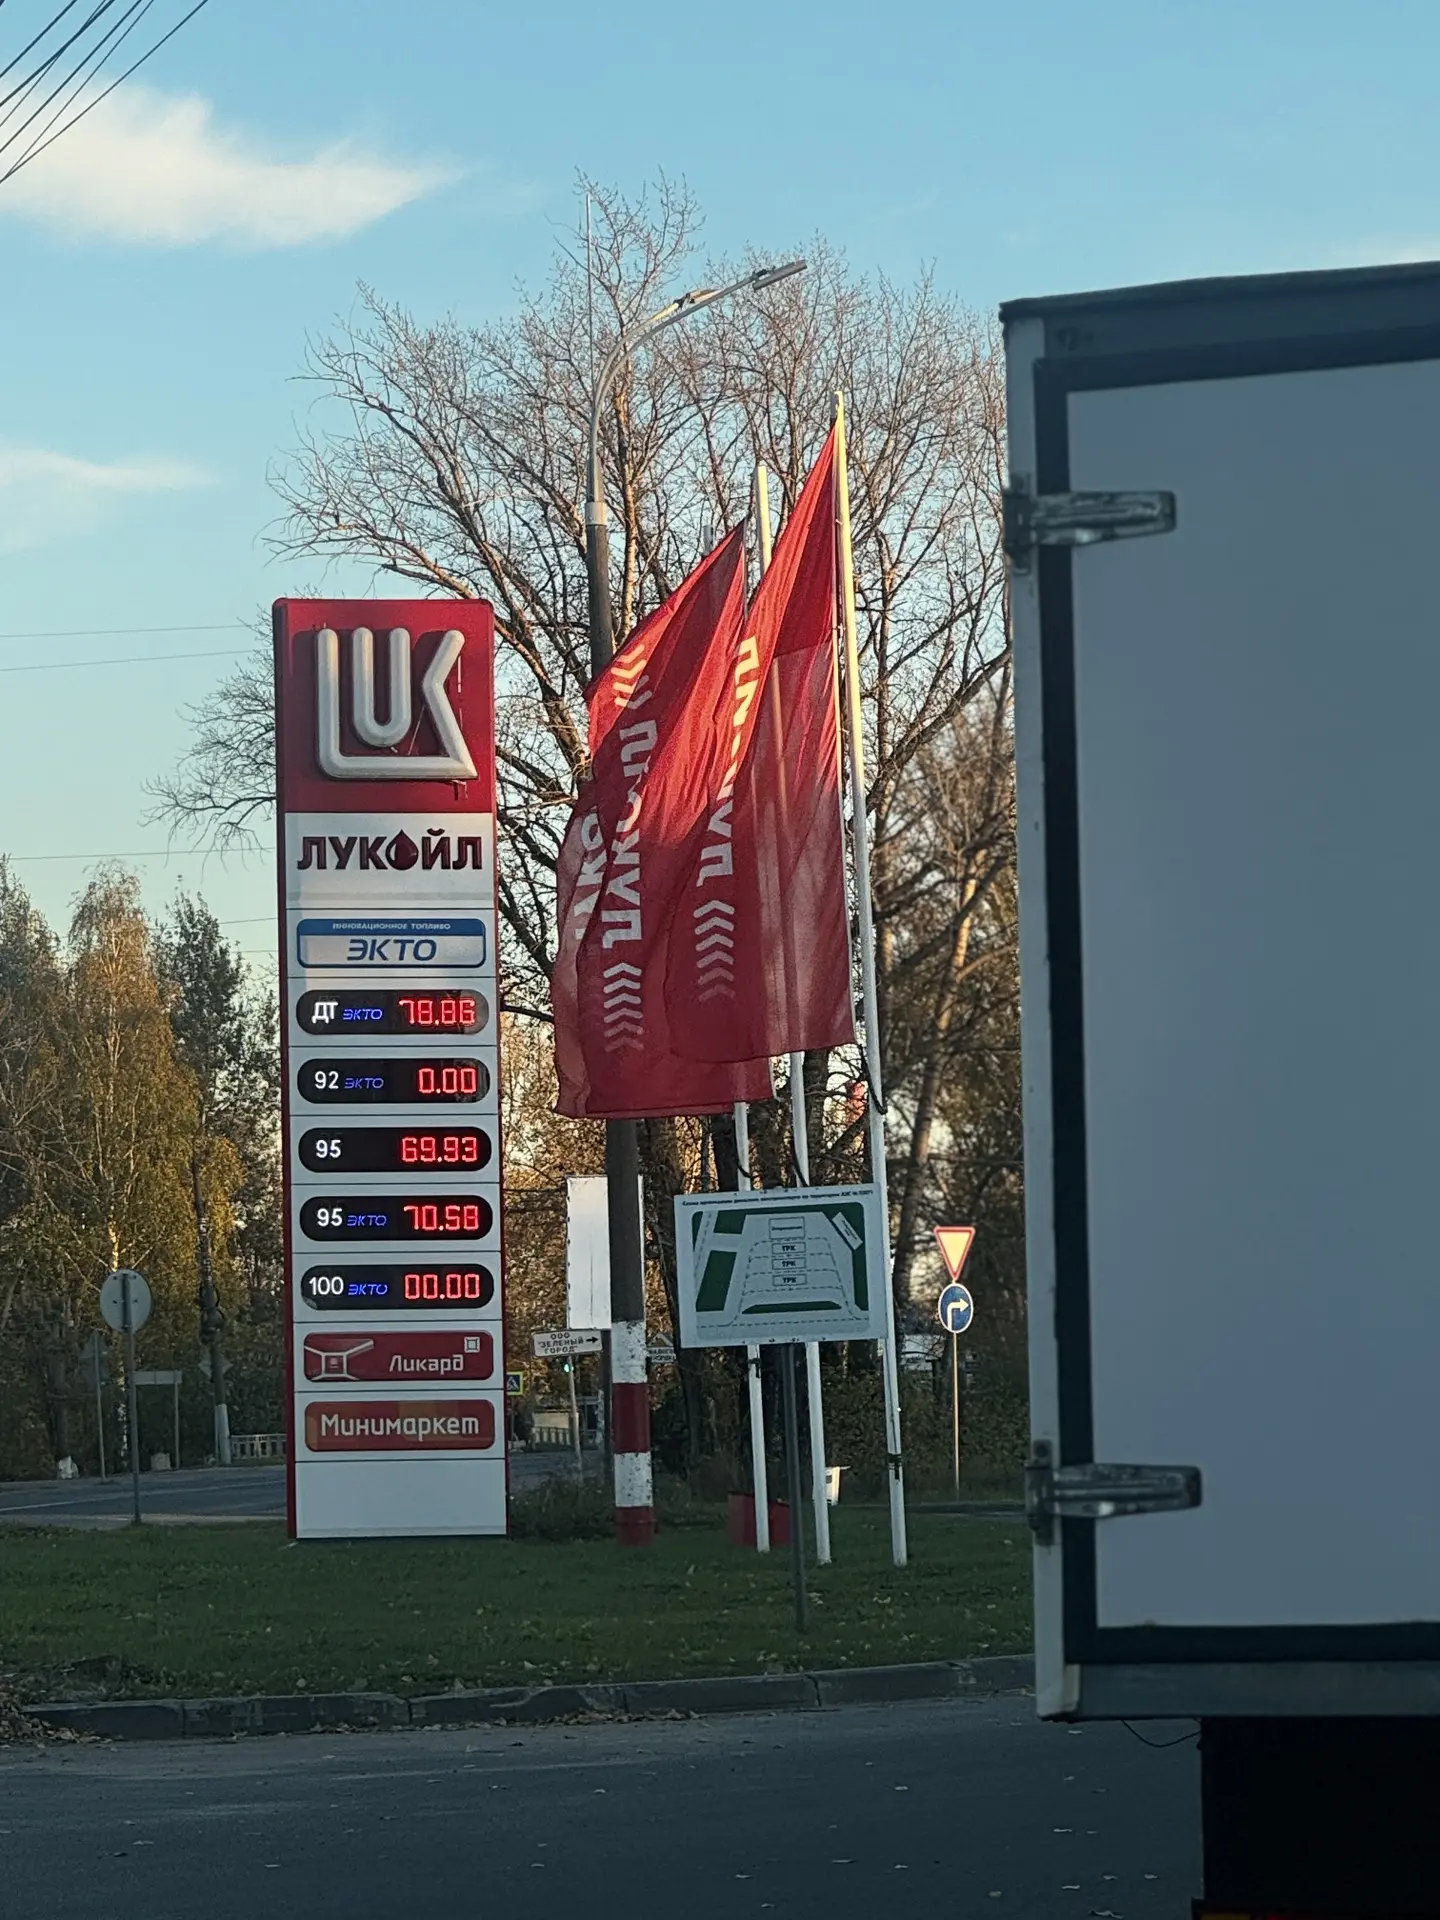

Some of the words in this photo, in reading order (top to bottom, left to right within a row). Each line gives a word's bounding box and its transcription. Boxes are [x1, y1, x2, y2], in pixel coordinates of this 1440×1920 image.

[297, 828, 482, 870] ЛУКОЙЛ
[332, 922, 408, 930] ИННОВАЦИОННОЕ
[411, 922, 451, 930] ТОПЛИВО
[346, 939, 437, 961] ЭКТО
[311, 1001, 338, 1024] ДТ
[342, 1008, 383, 1021] ЭКТО
[314, 1071, 339, 1090] 92
[344, 1077, 384, 1089] ЭКТО
[418, 1068, 477, 1094] 0.00
[315, 1139, 342, 1159] 95
[402, 1136, 478, 1162] 69.93
[316, 1207, 343, 1227] 95
[346, 1215, 387, 1227] ЭКТО
[403, 1205, 479, 1231] 70.58
[309, 1276, 344, 1296] 100
[348, 1283, 388, 1296] ЭКТО
[405, 1273, 480, 1299] 00.00
[550, 1332, 570, 1340] ООО
[389, 1354, 464, 1375] Ликард
[321, 1414, 479, 1441] Минимаркет
